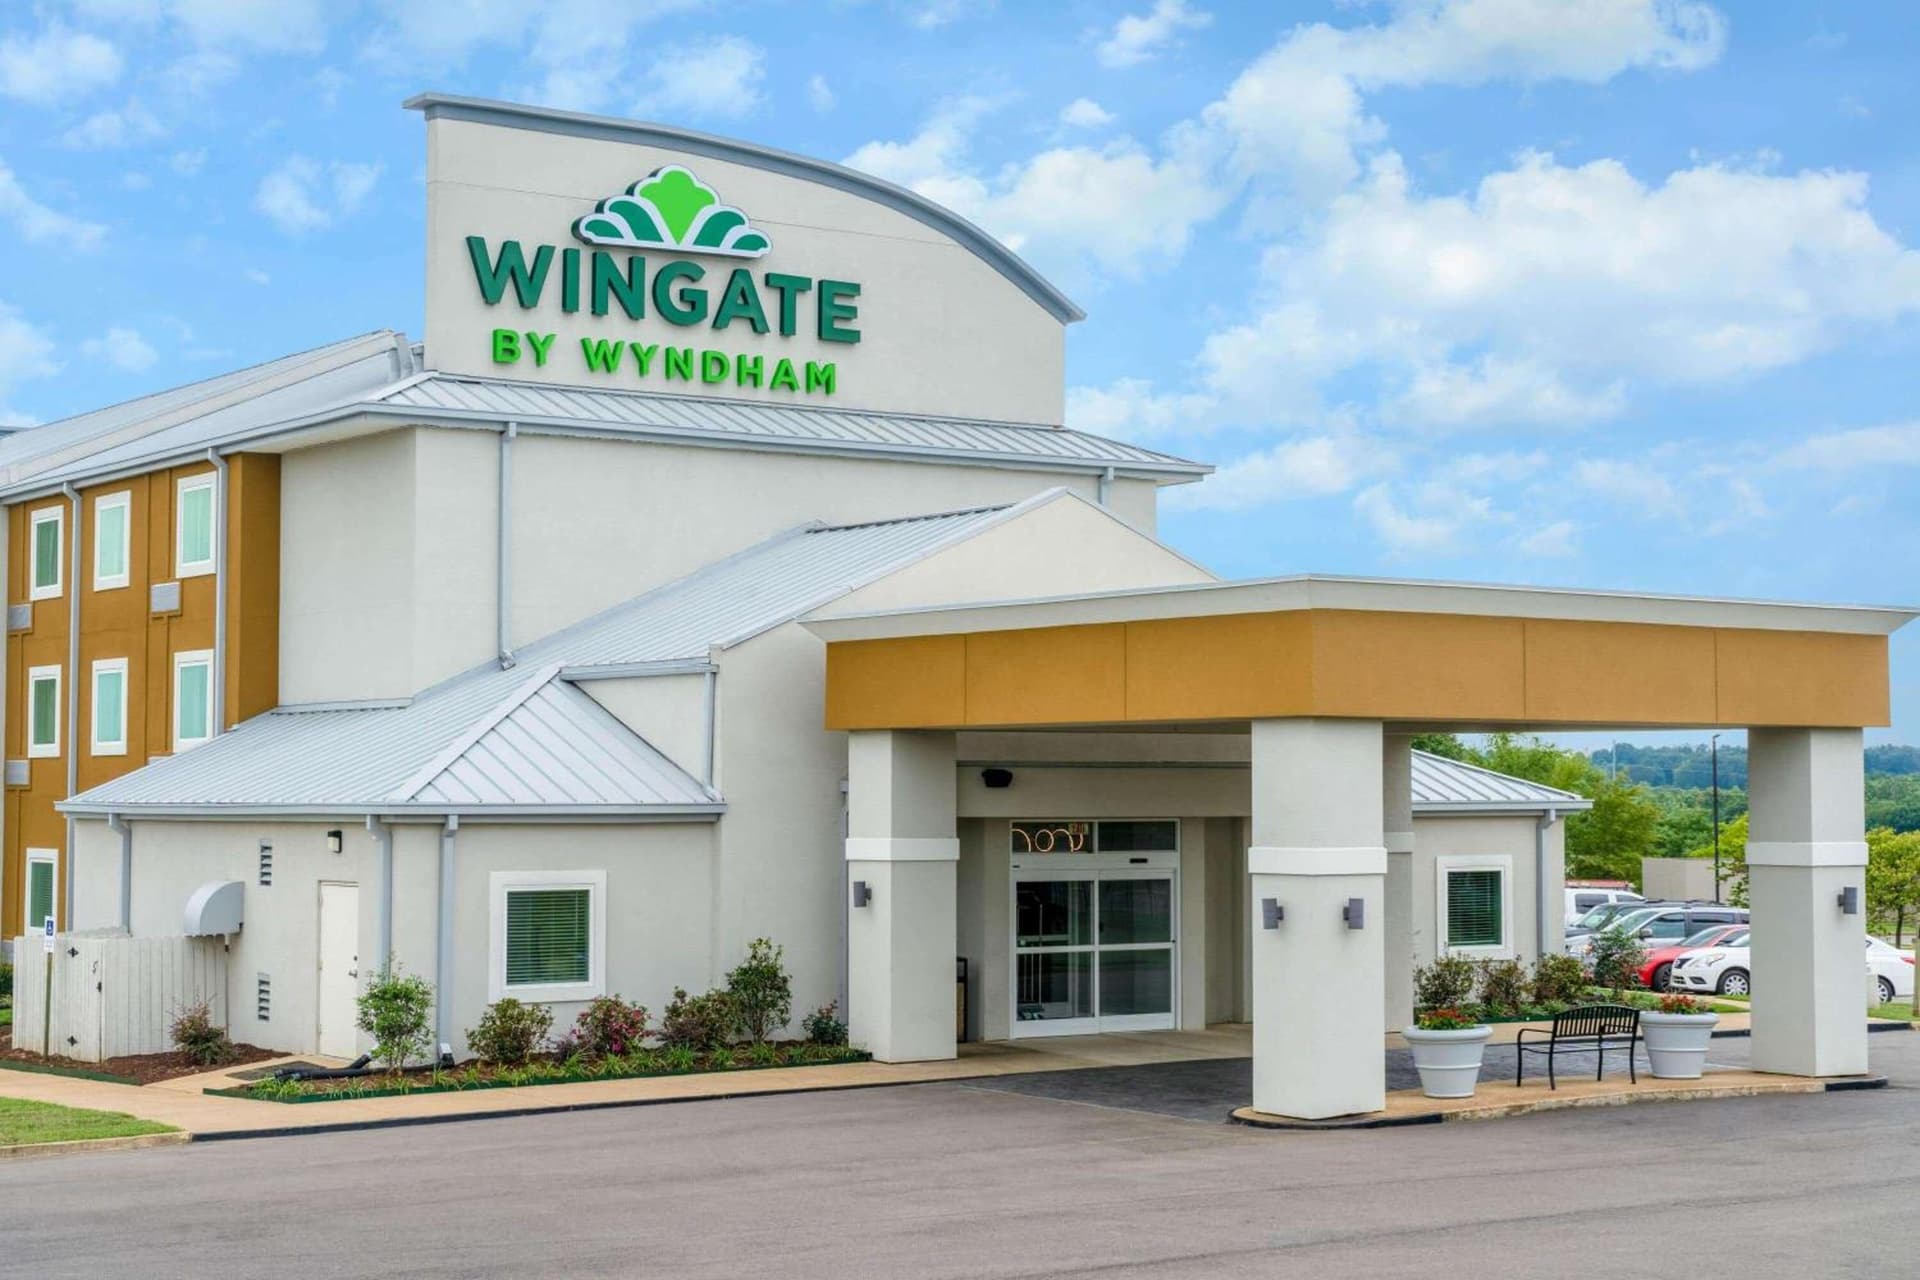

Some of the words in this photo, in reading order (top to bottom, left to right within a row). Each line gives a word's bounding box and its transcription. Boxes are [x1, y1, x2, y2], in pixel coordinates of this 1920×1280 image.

[465, 236, 861, 343] WINGATE
[492, 328, 556, 367] BY
[581, 337, 836, 395] WYNDHAM
